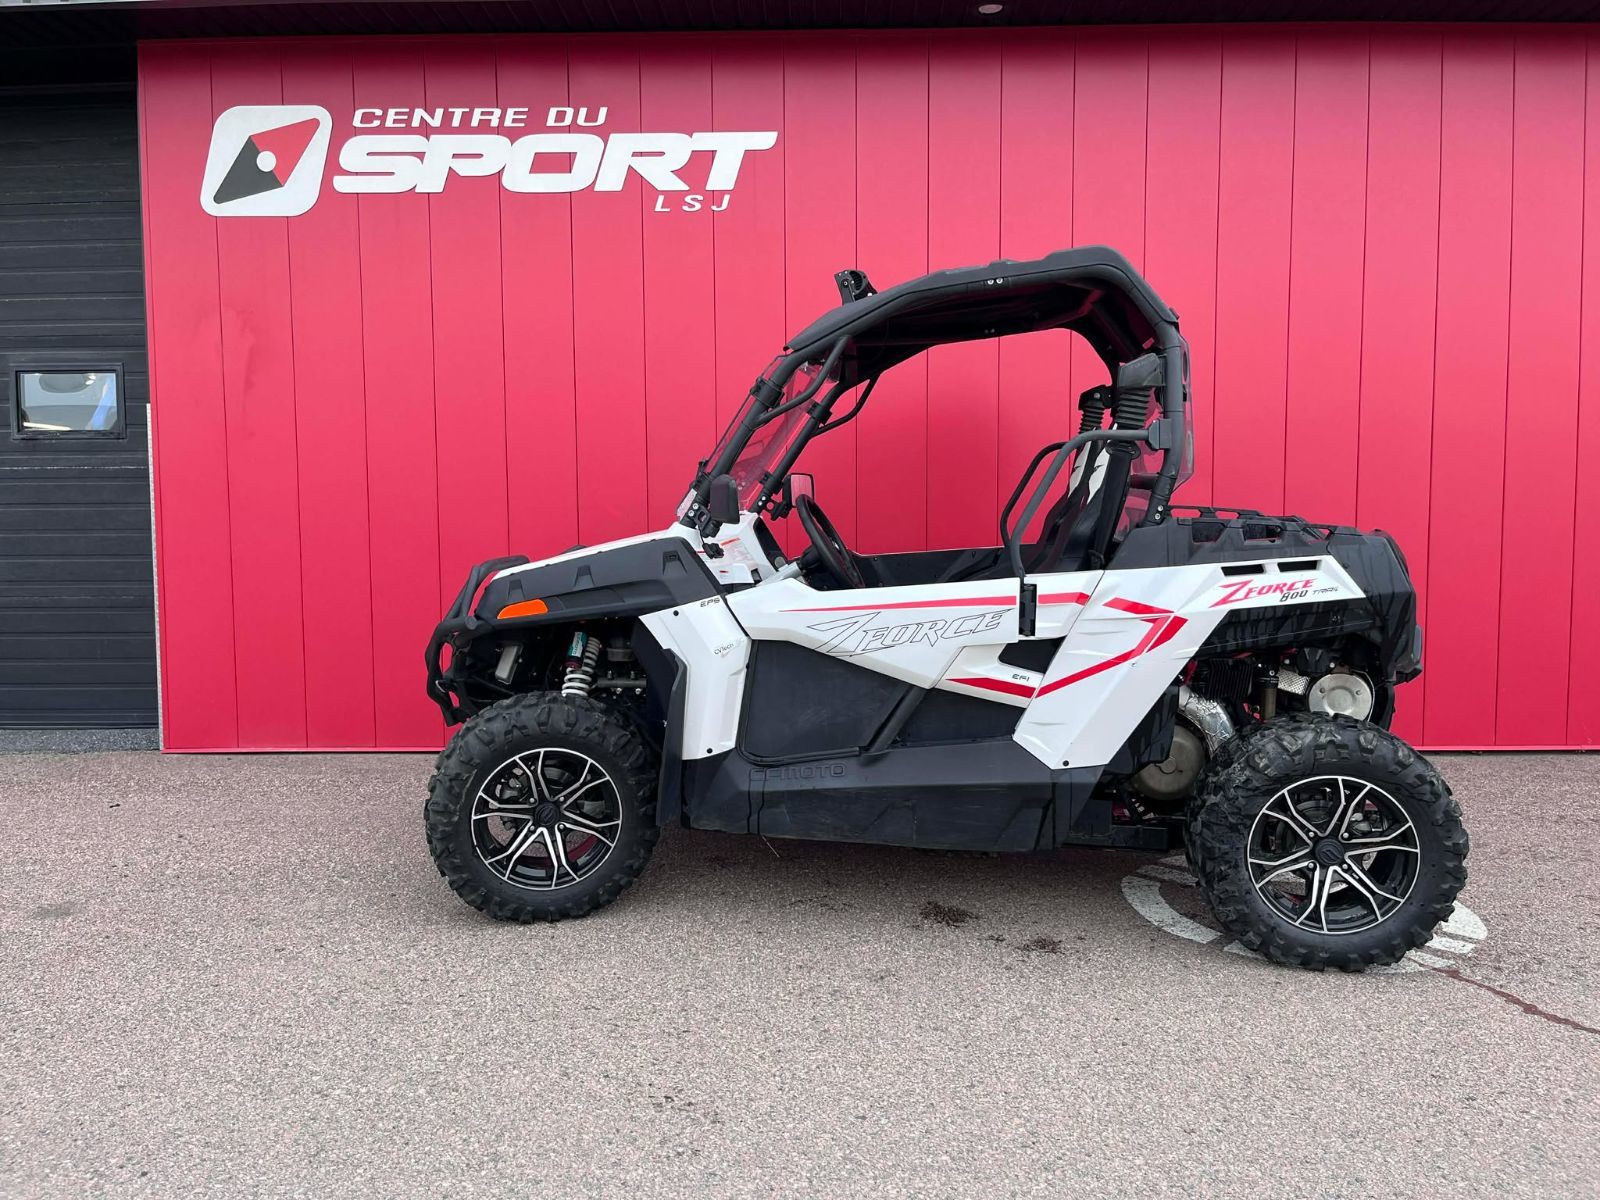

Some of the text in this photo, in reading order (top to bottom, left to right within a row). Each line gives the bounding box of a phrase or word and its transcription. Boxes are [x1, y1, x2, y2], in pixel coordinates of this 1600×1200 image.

[352, 106, 608, 128] CENTRE DU
[333, 131, 778, 193] SPORT
[700, 597, 720, 607] EPS
[1279, 589, 1308, 602] 800
[1012, 673, 1030, 681] EFI
